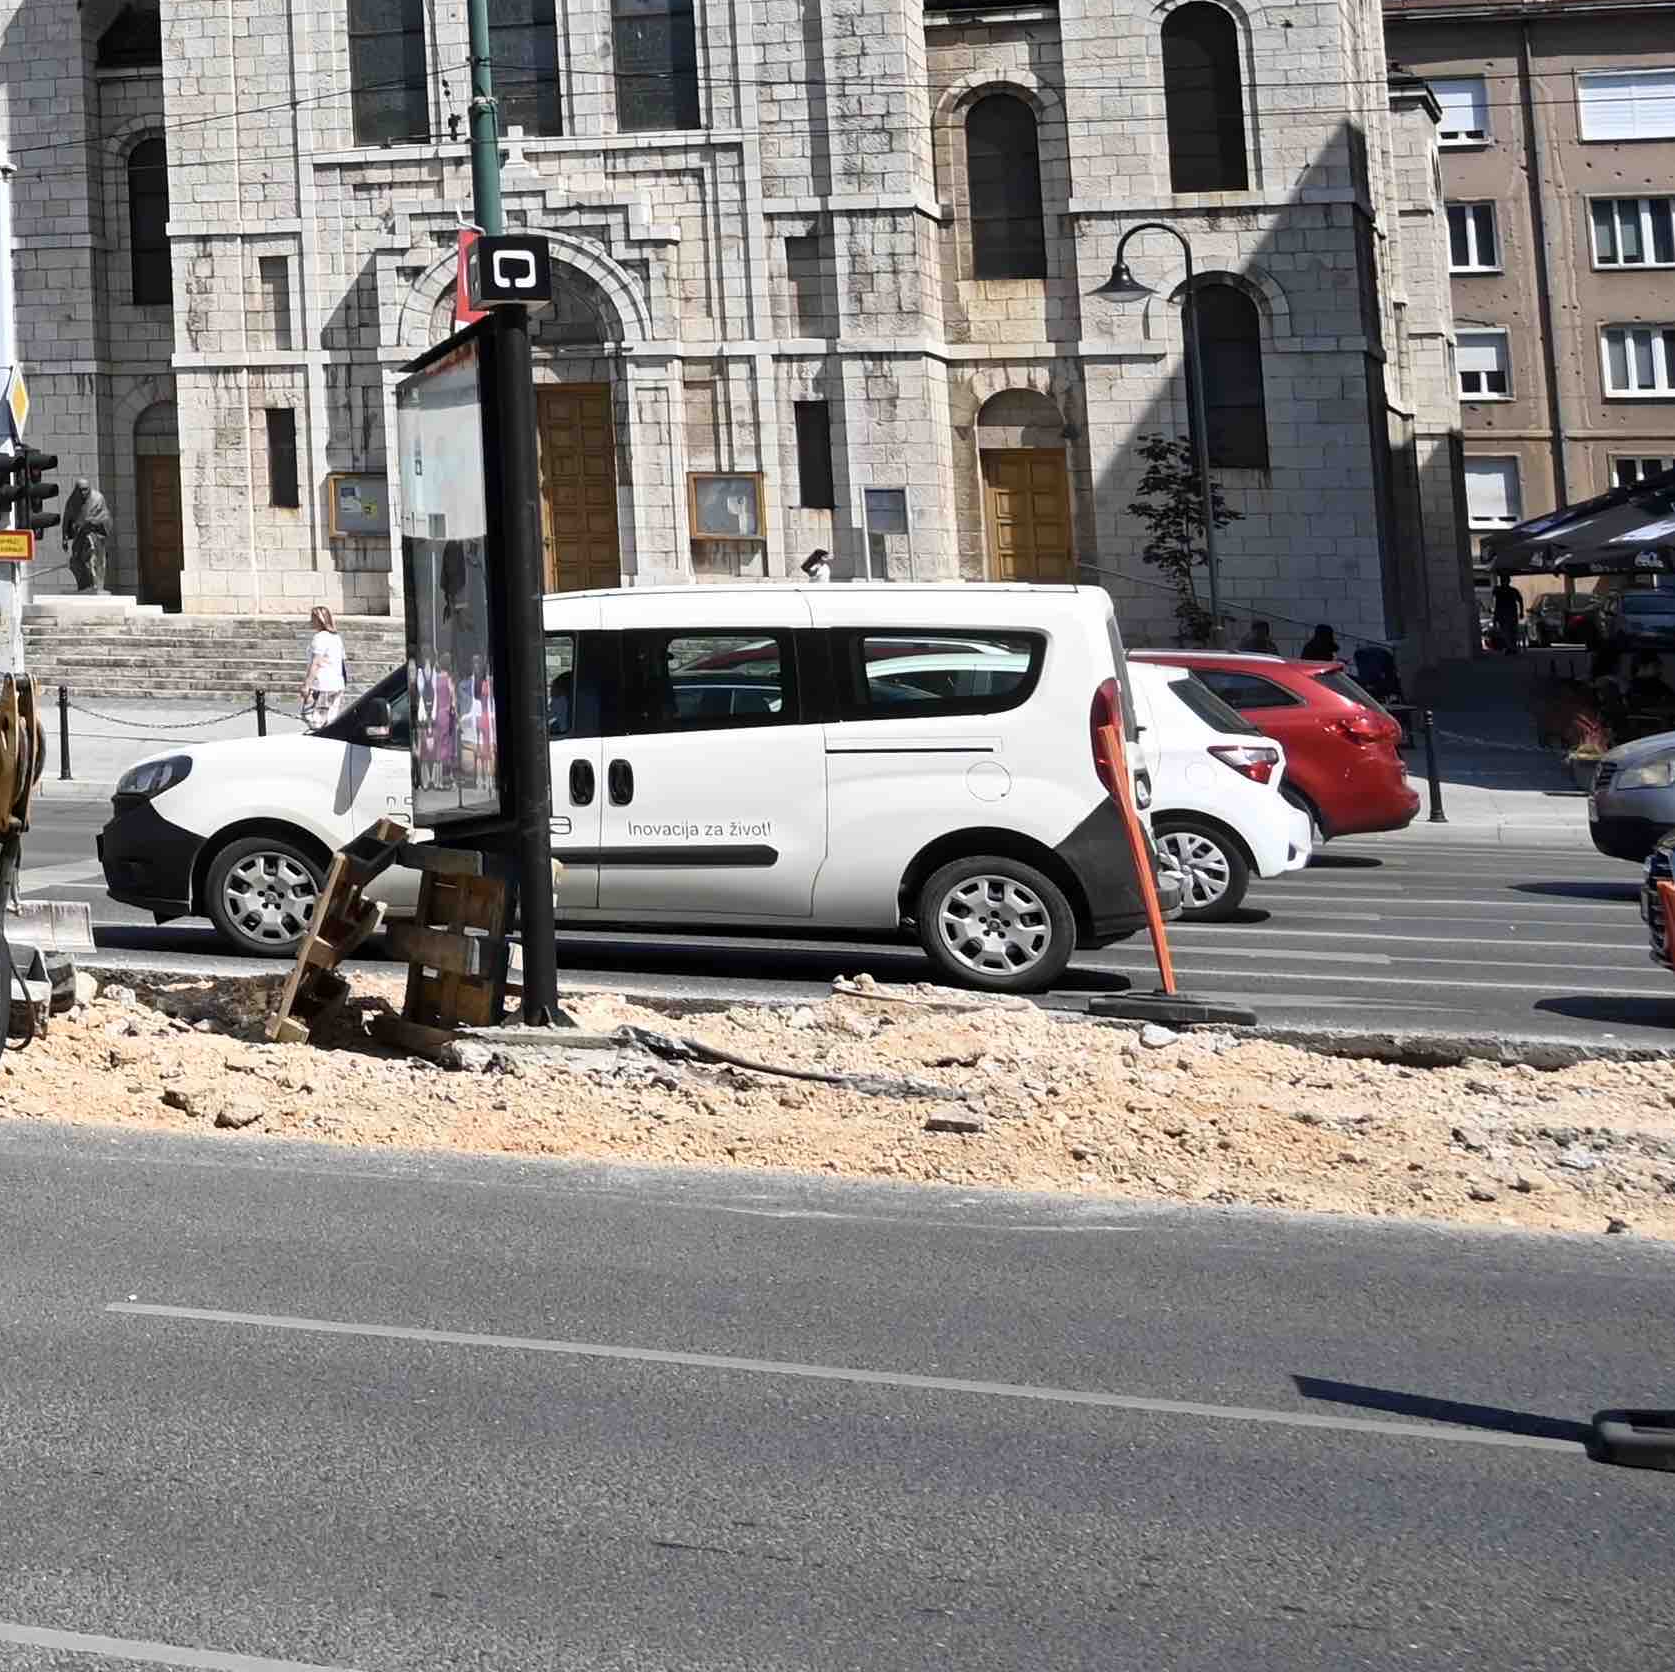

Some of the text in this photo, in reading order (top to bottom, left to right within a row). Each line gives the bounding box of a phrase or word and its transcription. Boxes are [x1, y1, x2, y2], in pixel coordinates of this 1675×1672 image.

[628, 819, 771, 840] Inovacija za život!
